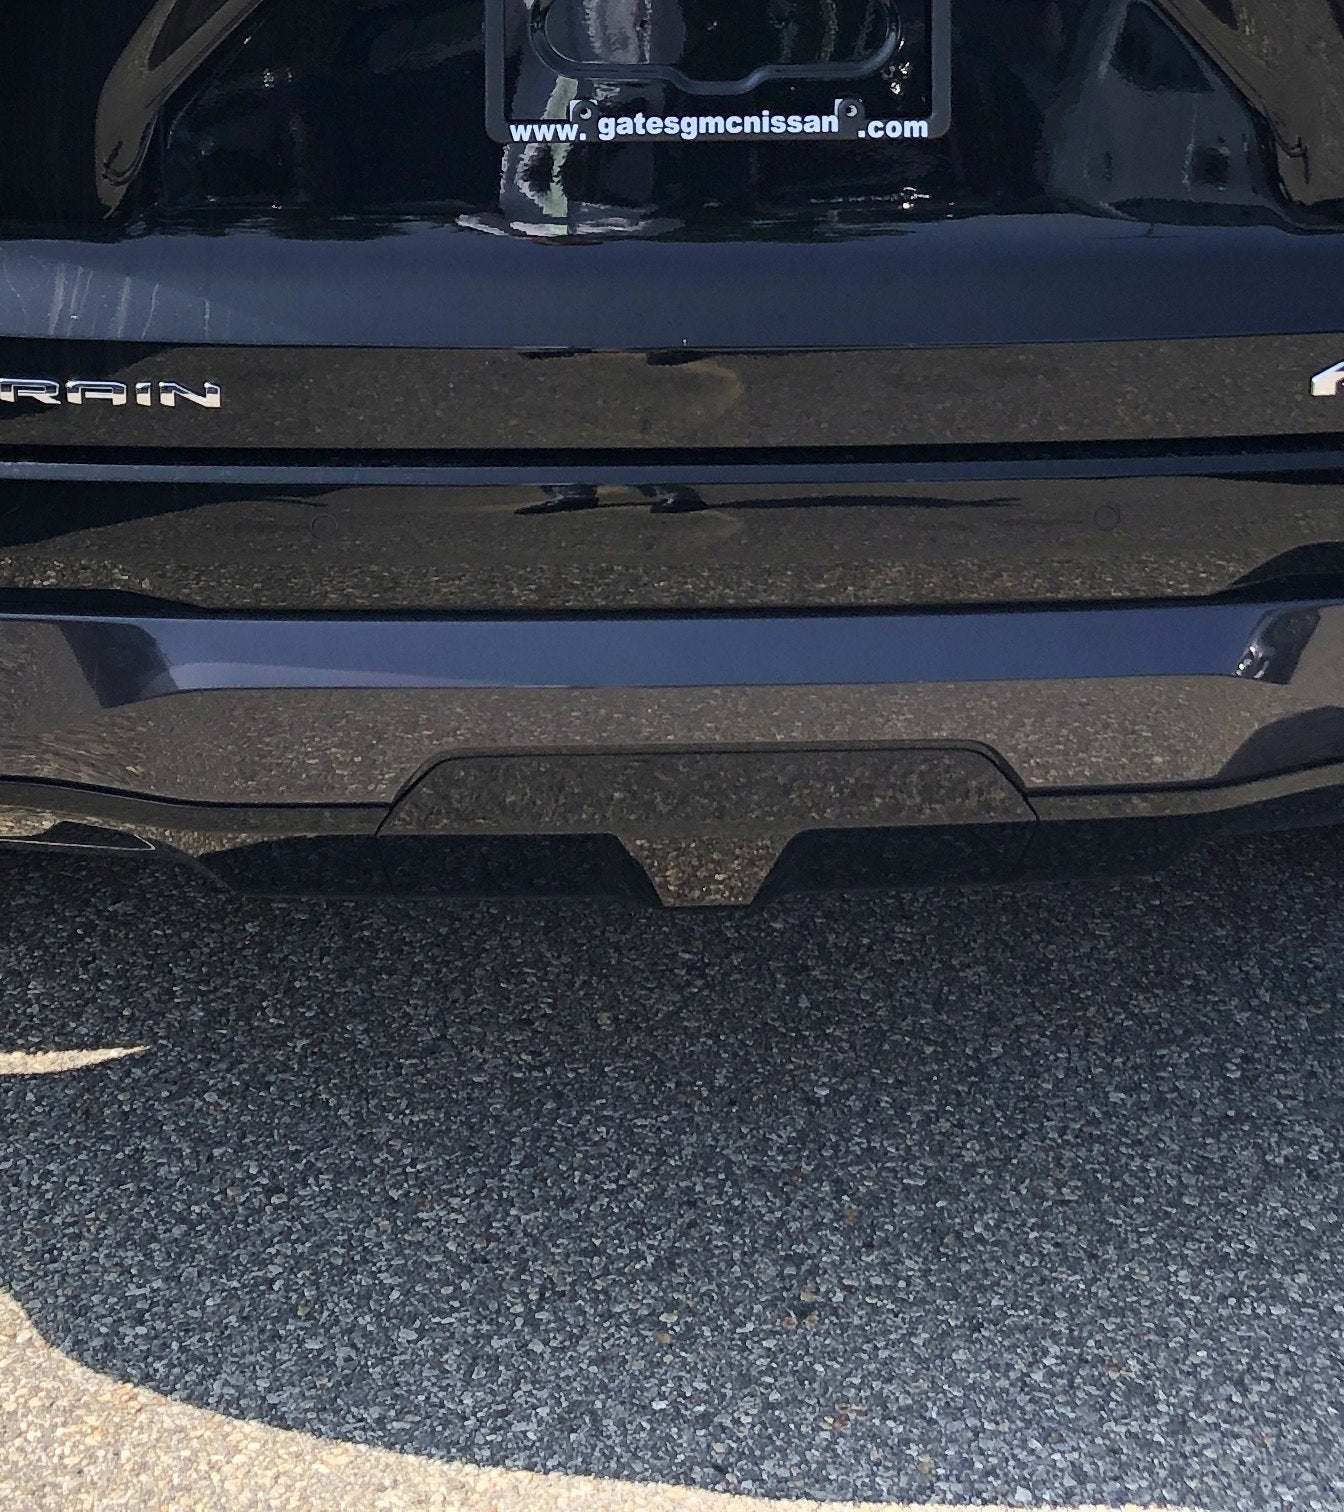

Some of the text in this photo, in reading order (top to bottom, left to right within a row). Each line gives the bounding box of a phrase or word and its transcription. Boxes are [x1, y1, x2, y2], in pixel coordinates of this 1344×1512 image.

[509, 110, 929, 142] www. gatesgmcnissan .com
